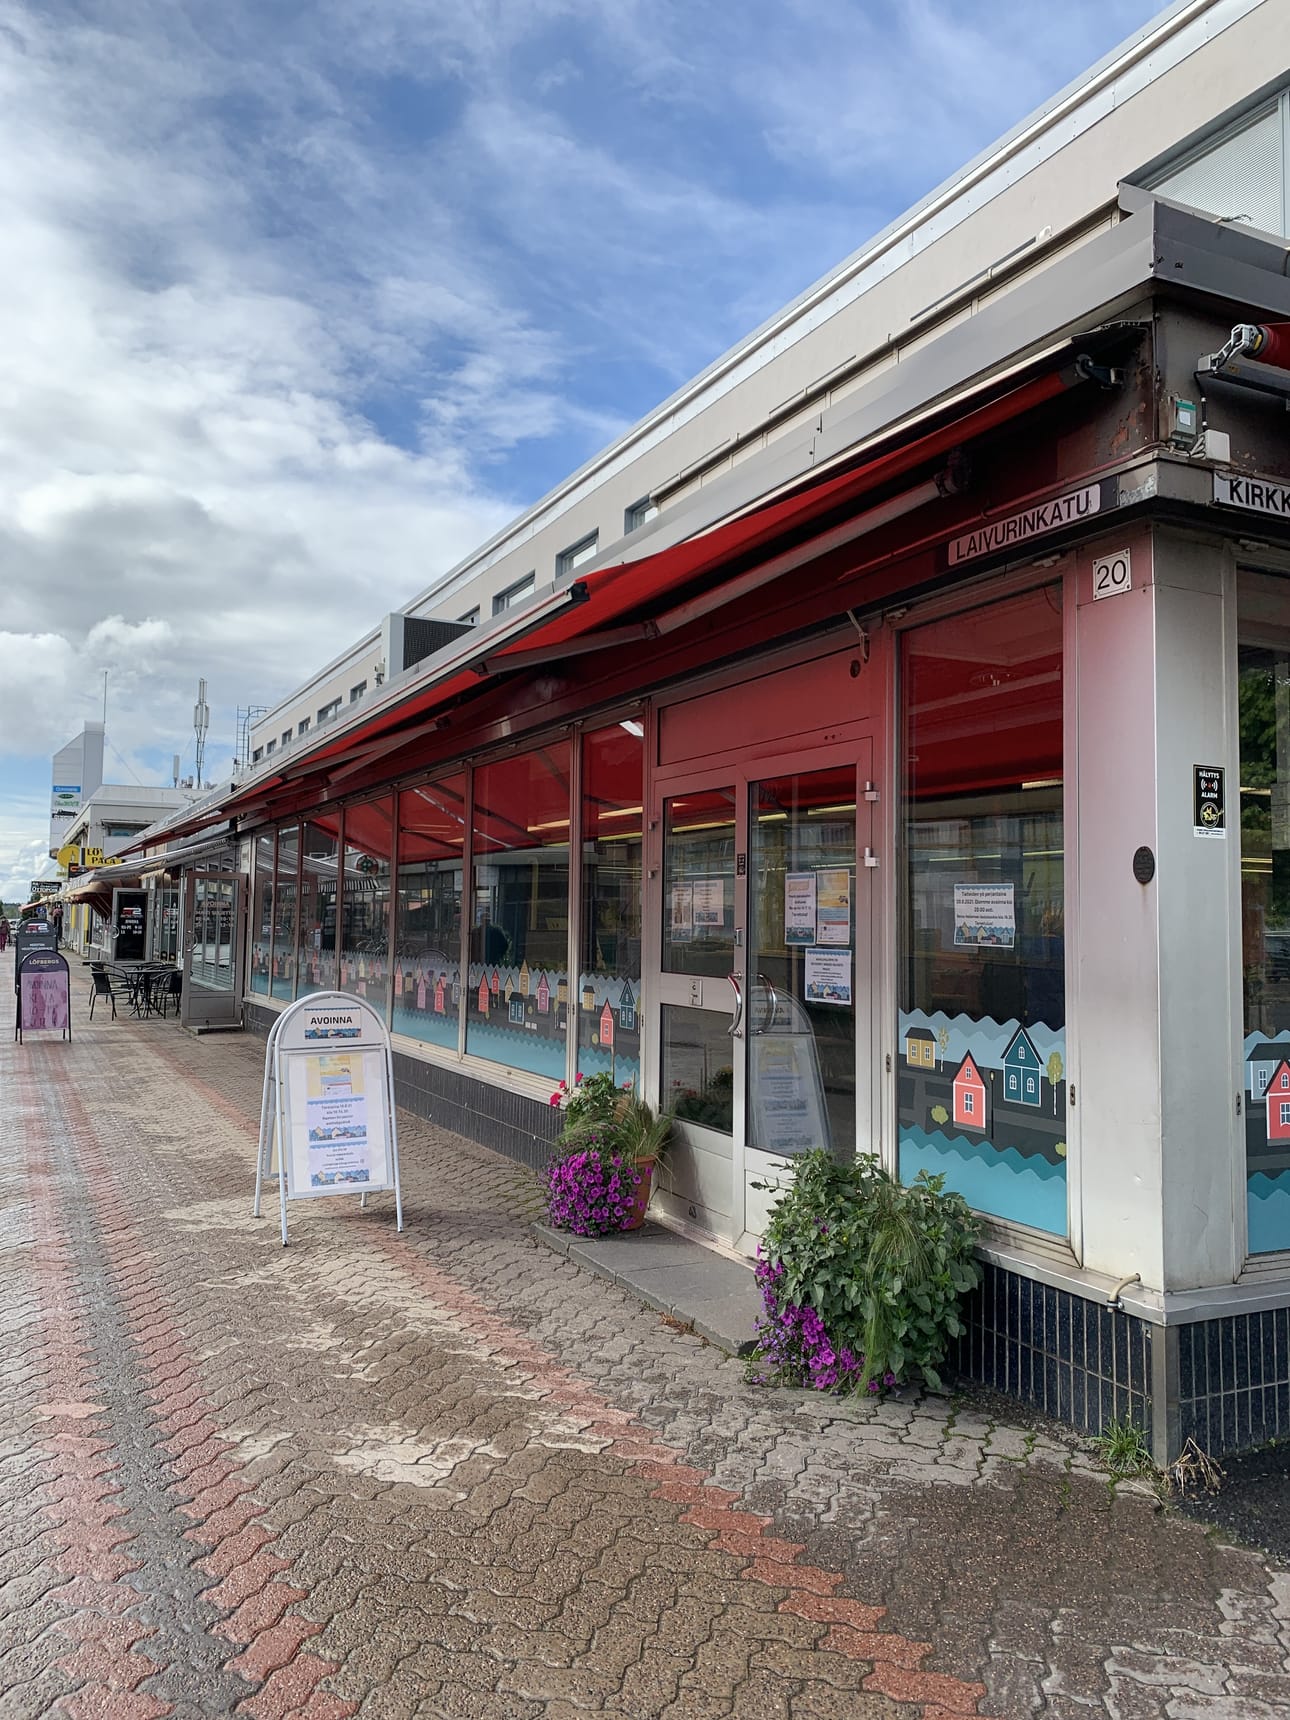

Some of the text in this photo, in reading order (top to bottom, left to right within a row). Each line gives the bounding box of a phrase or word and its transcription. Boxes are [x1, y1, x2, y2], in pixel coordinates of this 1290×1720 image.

[956, 490, 1090, 561] LAIVURINKATU
[1097, 559, 1127, 591] 20
[1198, 770, 1220, 779] HÄLYTYS
[1201, 791, 1218, 799] ALARM
[310, 1015, 353, 1025] AVOINNA
